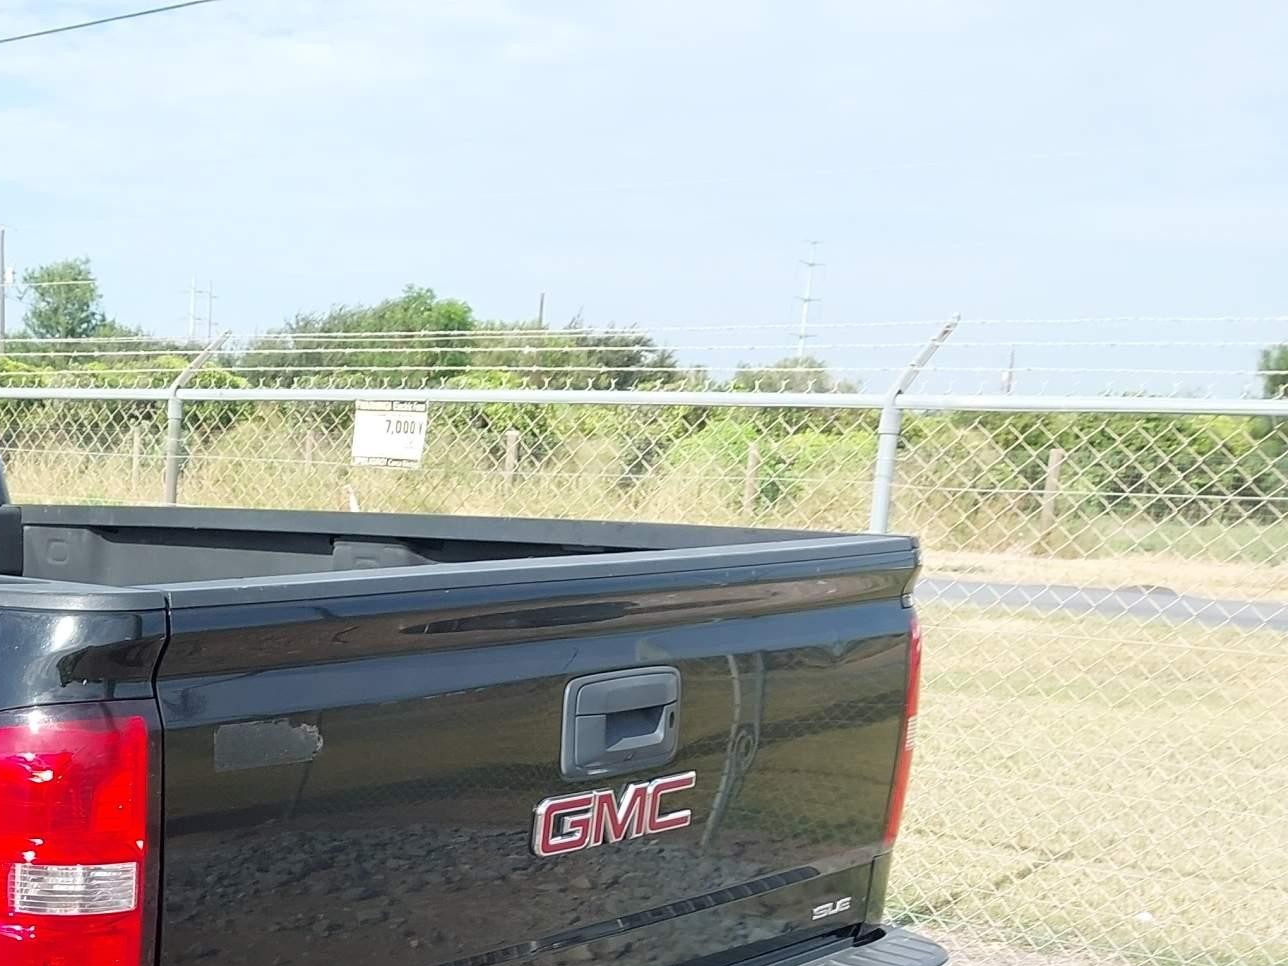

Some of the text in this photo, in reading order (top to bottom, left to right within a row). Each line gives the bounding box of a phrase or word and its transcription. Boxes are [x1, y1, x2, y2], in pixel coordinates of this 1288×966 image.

[385, 419, 416, 435] 7,000
[532, 769, 697, 858] GMC
[812, 896, 852, 921] SLE
